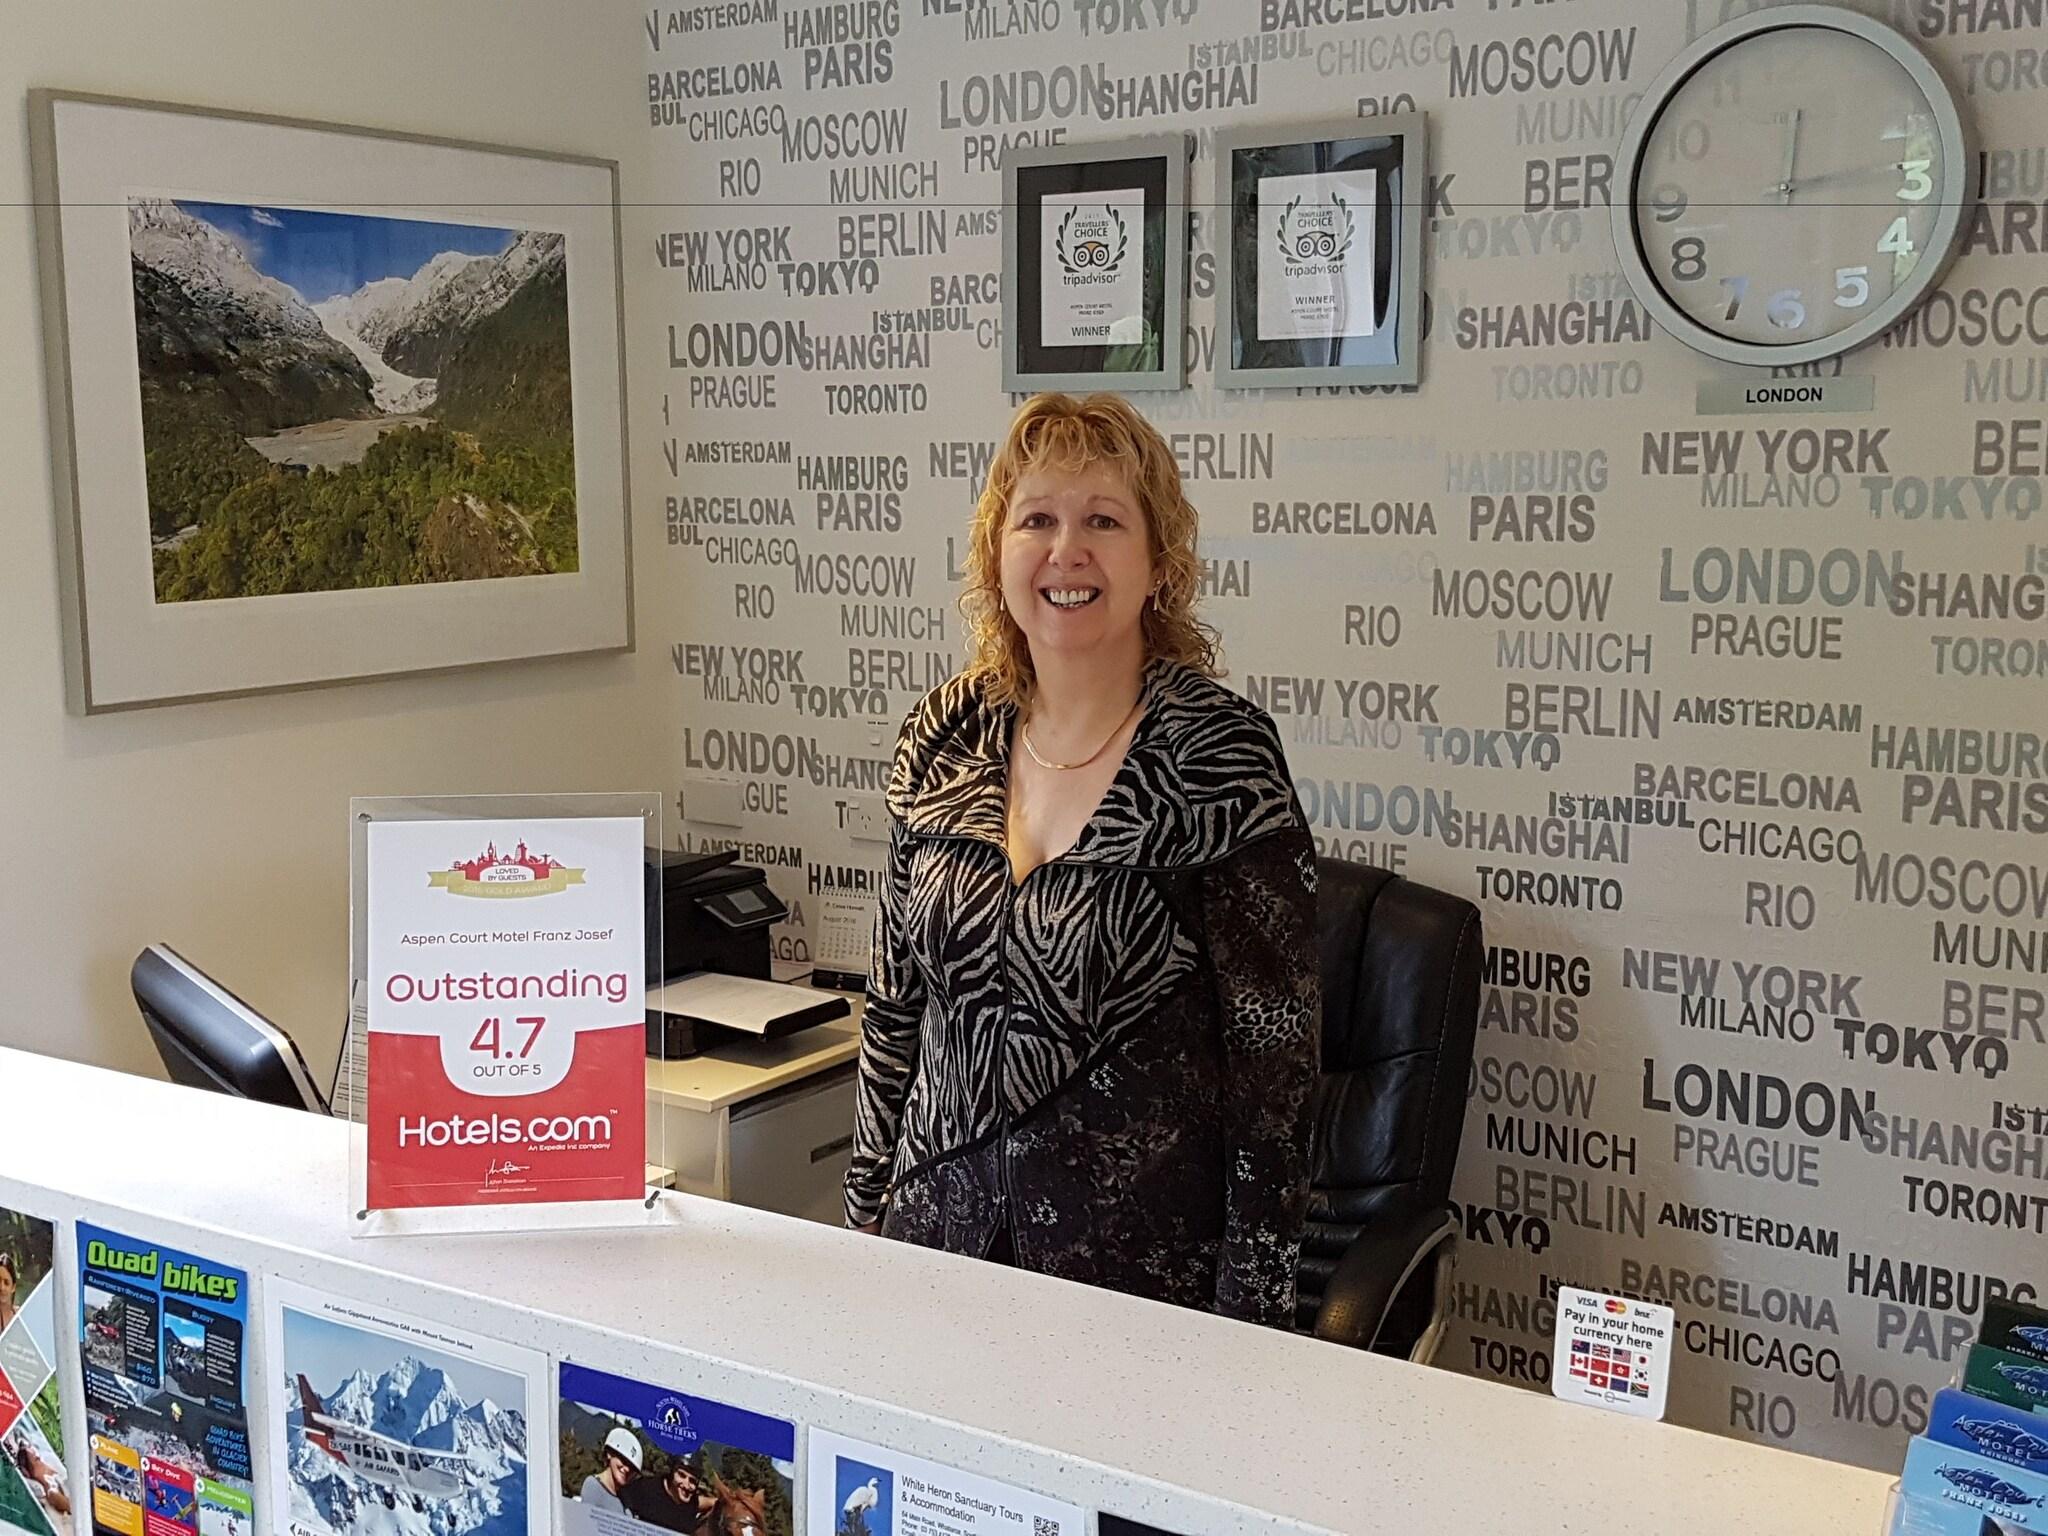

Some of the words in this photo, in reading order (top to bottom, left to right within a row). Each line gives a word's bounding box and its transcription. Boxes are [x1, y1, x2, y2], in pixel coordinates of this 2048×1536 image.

[667, 0, 778, 34] AMSTERDAM
[784, 0, 900, 49] HAMBURG
[964, 0, 1061, 41] MILANO
[1074, 0, 1198, 37] TOKYO
[1261, 0, 1455, 32] BARCELONA
[805, 41, 893, 90] PARIS
[1188, 31, 1313, 71] ISTANBUL
[1317, 28, 1455, 77] CHICAGO
[1449, 27, 1637, 98] MOSCOW
[648, 60, 782, 102] BARCELONA
[940, 62, 1105, 129] LONDON
[1100, 64, 1258, 121] SHANGHAI
[689, 104, 784, 141] CHICAGO
[782, 108, 908, 163] MOSCOW
[1666, 119, 1711, 162] 10
[719, 158, 760, 197] RIO
[830, 161, 938, 203] MUNICH
[1896, 159, 1933, 200] 3
[1297, 217, 1333, 228] CHOICE
[1651, 183, 1689, 223] 9
[656, 232, 708, 268] NEW
[716, 226, 793, 266] YORK
[838, 210, 946, 259] BERLIN
[1074, 228, 1109, 238] CHOICE
[1432, 212, 1582, 260] TOKYO
[1877, 217, 1913, 256] 4
[687, 263, 767, 293] MILANO
[778, 259, 879, 297] TOKYO
[1285, 264, 1345, 278] tripadvisor
[1670, 237, 1706, 281] 8
[1063, 272, 1118, 288] tripadvisor
[1295, 295, 1336, 305] WINNER
[1720, 275, 1750, 320] 7
[1833, 266, 1868, 308] 5
[873, 307, 974, 334] ISTANBUL
[1456, 300, 1652, 350] SHANGHAI
[1767, 289, 1806, 329] 6
[668, 321, 806, 368] LONDON
[1071, 325, 1111, 337] WINNER
[800, 333, 931, 371] SHANGHAI
[691, 375, 776, 409] PRAGUE
[825, 383, 927, 415] TORONTO
[1492, 361, 1643, 401] TORONTO
[1745, 387, 1823, 404] LONDON
[685, 441, 791, 464] AMSTERDAM
[929, 442, 996, 478] NEW
[1446, 449, 1608, 494] HAMBURG
[1641, 430, 1743, 475] NEW
[1756, 428, 1891, 475] YORK
[797, 455, 908, 492] HAMBURG
[1700, 472, 1841, 509] MILANO
[666, 496, 795, 526] BARCELONA
[817, 493, 901, 532] PARIS
[1252, 502, 1437, 536] BARCELONA
[1469, 495, 1595, 543] PARIS
[1859, 476, 2042, 521] TOKYO
[705, 536, 798, 567] CHICAGO
[795, 554, 915, 598] MOSCOW
[1432, 568, 1612, 622] MOSCOW
[1660, 547, 1904, 607] LONDON
[735, 583, 775, 619] RIO
[840, 604, 944, 641] MUNICH
[1345, 604, 1401, 648] RIO
[1691, 613, 1843, 660] PRAGUE
[672, 644, 725, 676] NEW
[732, 648, 804, 683] YORK
[848, 648, 952, 693] BERLIN
[1496, 629, 1652, 674] MUNICH
[704, 676, 779, 705] MILANO
[790, 684, 888, 718] TOKYO
[1246, 675, 1325, 716] NEW
[1334, 680, 1440, 724] YORK
[1505, 682, 1661, 739] BERLIN
[1293, 715, 1401, 751] MILANO
[1673, 697, 1862, 732] AMSTERDAM
[684, 727, 816, 778] LONDON
[1417, 726, 1561, 772] TOKYO
[1871, 724, 2048, 779] HAMBUR
[1634, 762, 1862, 813] BARCELONA
[1901, 774, 2048, 834] PARIS
[1549, 791, 1695, 829] ISTANBUL
[1445, 808, 1630, 864] SHANGHAI
[1699, 818, 1863, 866] CHICAGO
[498, 873, 527, 881] GUESTS
[1476, 865, 1623, 912] TORONTO
[1746, 881, 1816, 930] RIO
[401, 933, 445, 946] Aspen
[450, 932, 488, 944] Court
[492, 931, 529, 942] Motel
[533, 930, 571, 942] Franz
[575, 929, 614, 941] Josef
[386, 969, 627, 1003] Outstanding
[1622, 948, 1720, 998] NEW
[1732, 960, 1862, 1018] YORK
[470, 1017, 546, 1059] 4.7
[1680, 994, 1815, 1042] MILANO
[1834, 1018, 2009, 1079] TOKYO
[473, 1065, 505, 1078] OUT
[509, 1064, 529, 1076] OF
[532, 1064, 541, 1075] 5
[1642, 1058, 1876, 1142] LONDON
[399, 1113, 611, 1148] Hotels.com
[578, 1143, 610, 1151] company
[1486, 1113, 1637, 1175] MUNICH
[1674, 1123, 1820, 1188] PRAGUE
[1495, 1164, 1647, 1239] BERLIN
[1657, 1202, 1840, 1258] AMSTERDAM
[88, 1240, 158, 1276] Quad
[163, 1261, 239, 1300] bikes
[1576, 1296, 1598, 1308] VISA
[1621, 1258, 1839, 1335] BARCELONA
[1634, 1307, 1651, 1319] bnz
[1564, 1308, 1586, 1323] Pay
[1588, 1312, 1599, 1324] in
[1602, 1317, 1629, 1330] your
[1632, 1321, 1664, 1338] home
[1573, 1326, 1624, 1345] currency
[1626, 1335, 1653, 1350] here
[1684, 1321, 1840, 1383] CHICAGO
[648, 1419, 672, 1433] HORSE
[1729, 1385, 1796, 1439] RIO
[1978, 1437, 2031, 1460] MOTEL
[901, 1491, 907, 1502] &
[909, 1494, 976, 1523] Accommodation
[902, 1475, 925, 1492] White
[928, 1483, 952, 1500] Heron
[955, 1492, 997, 1517] Sanctuary
[999, 1505, 1024, 1523] Tours
[1942, 1488, 1984, 1509] FRANZ
[1989, 1504, 2027, 1523] JOSEF
[1960, 1484, 2012, 1507] MOTEL
